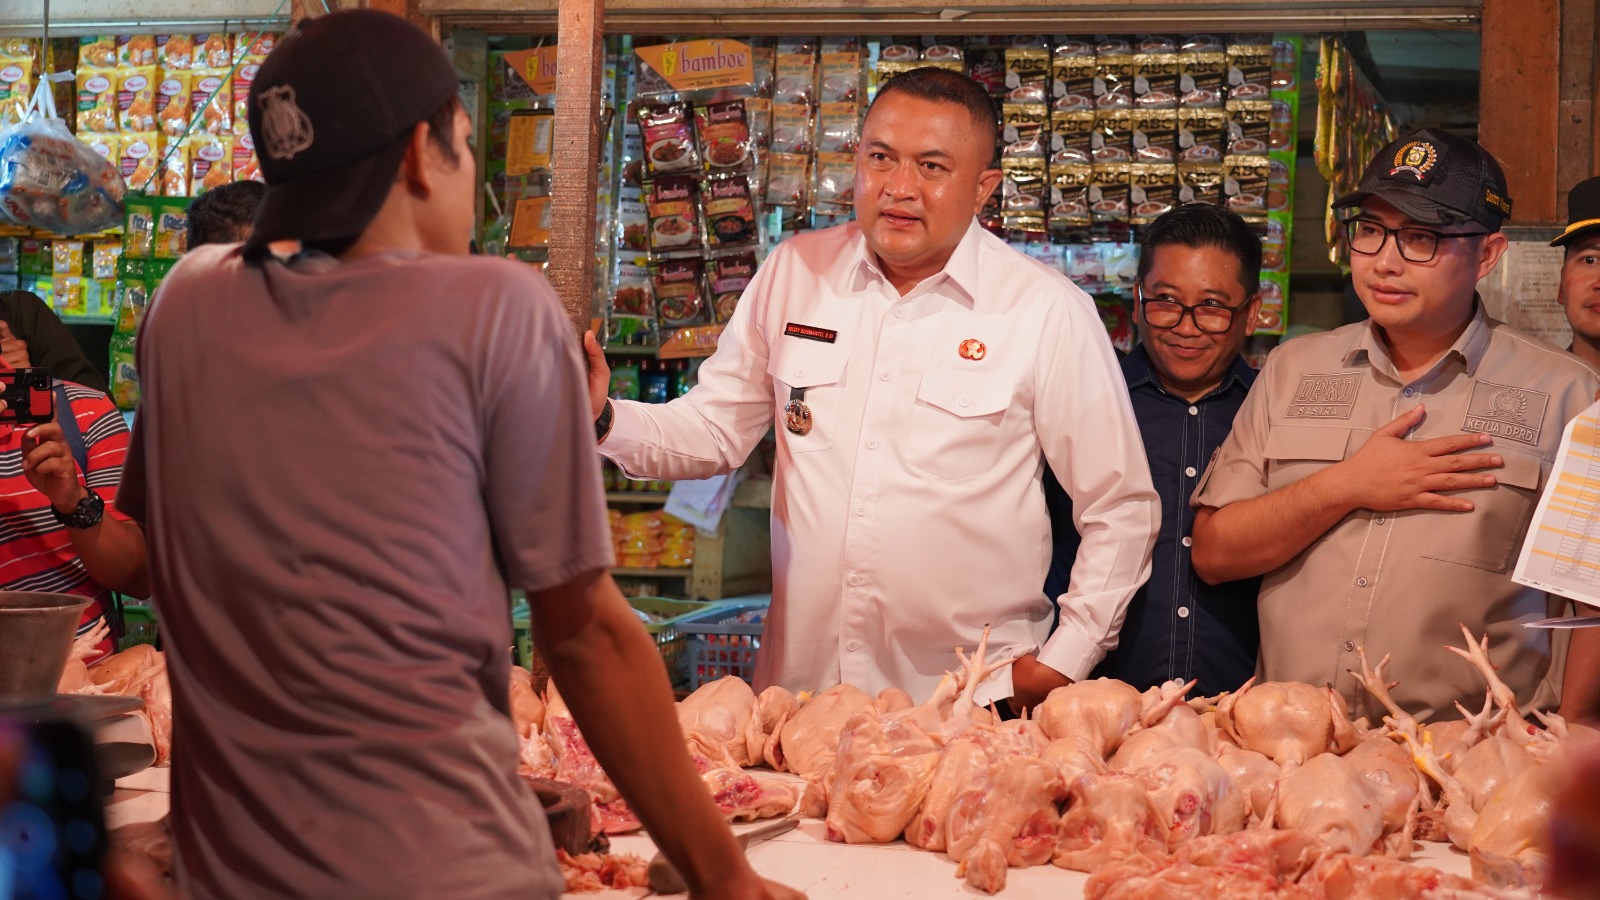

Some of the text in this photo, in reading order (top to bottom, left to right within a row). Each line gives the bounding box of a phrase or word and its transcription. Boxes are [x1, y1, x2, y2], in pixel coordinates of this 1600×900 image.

[680, 45, 747, 74] bamboe
[1010, 58, 1045, 70] ABC
[1233, 55, 1269, 66] ABC
[1056, 66, 1091, 78] ABC
[1095, 64, 1130, 76] ABC
[1138, 63, 1173, 75] ABC
[1184, 61, 1219, 73] ABC
[1008, 113, 1042, 123] ABC
[1231, 110, 1267, 122] ABC
[1054, 120, 1089, 132] ABC
[1093, 118, 1130, 131] ABC
[1137, 118, 1173, 130] ABC
[1183, 117, 1219, 129] ABC
[1229, 166, 1266, 177] ABC
[1091, 172, 1127, 184] ABC
[1135, 173, 1171, 185] ABC
[1296, 376, 1357, 402] DPRD
[1296, 405, 1338, 416] SASTRA
[1466, 417, 1535, 442] KETUA DPRD
